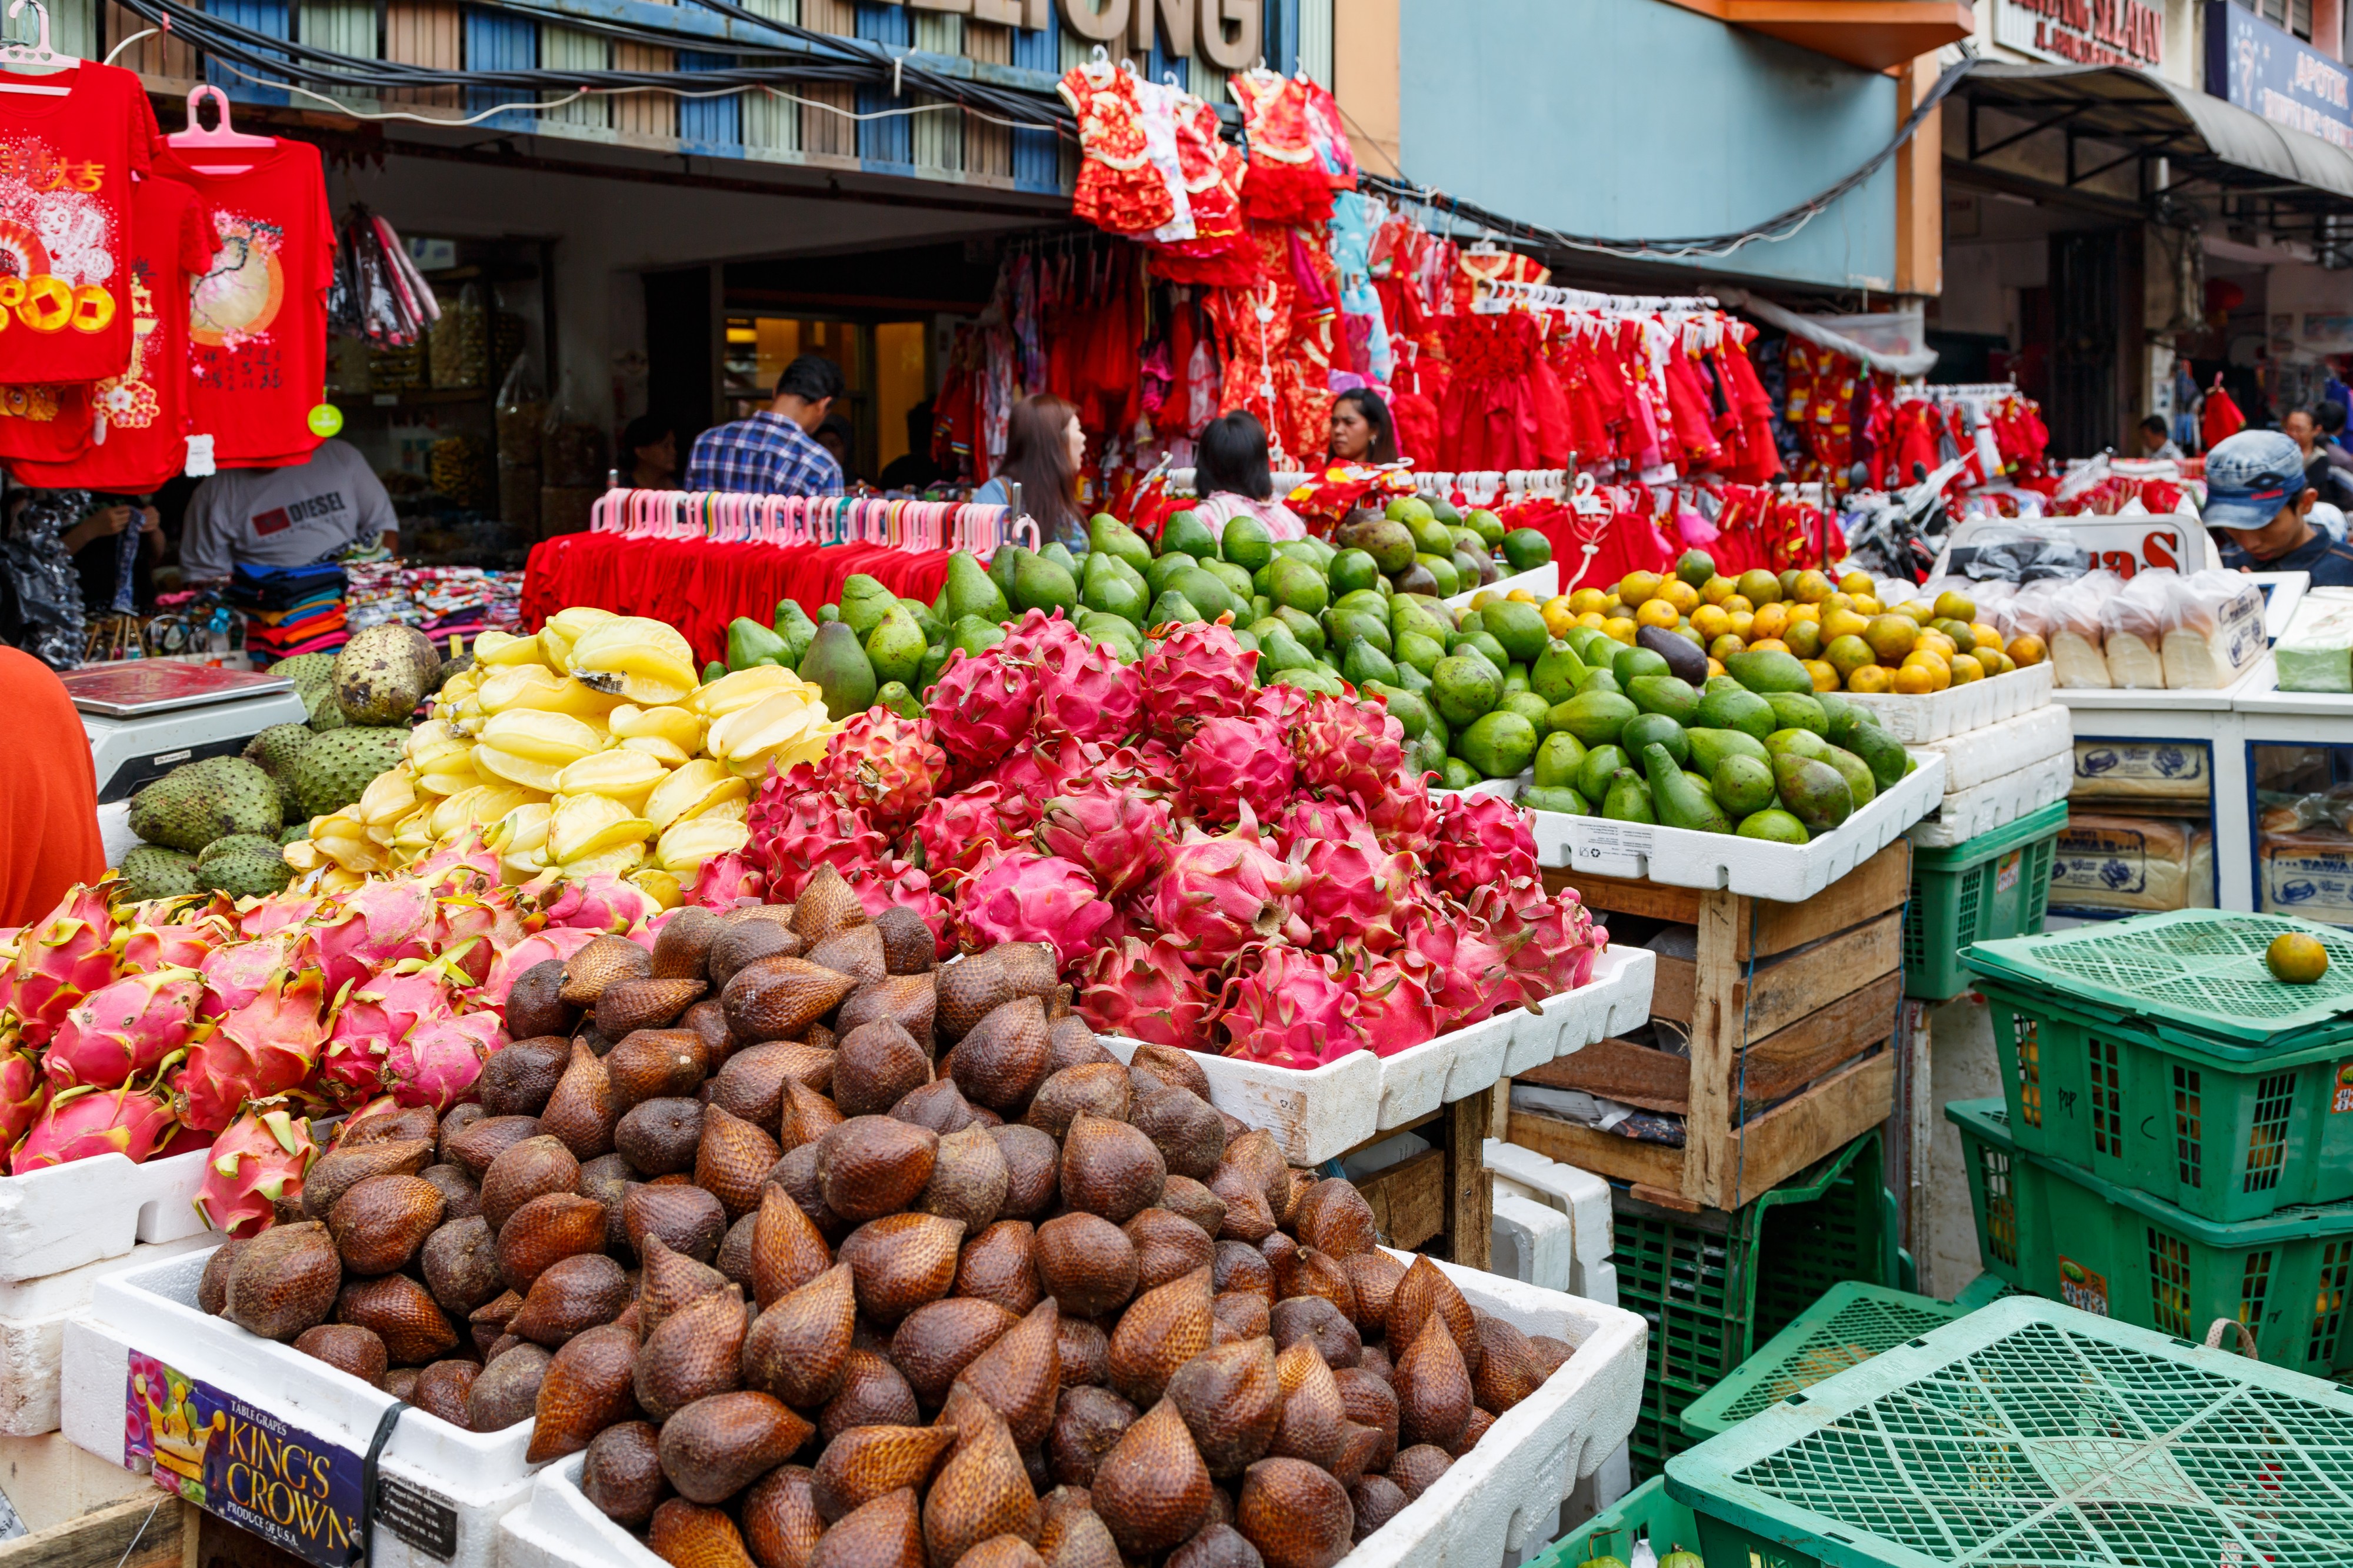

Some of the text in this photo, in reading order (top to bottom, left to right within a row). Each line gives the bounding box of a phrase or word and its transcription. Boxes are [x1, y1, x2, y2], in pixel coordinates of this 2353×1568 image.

[2294, 51, 2349, 111] APOTIK
[288, 491, 346, 522] DIESEL
[2299, 859, 2353, 874] TAWA
[231, 1400, 287, 1436] TABLE GRAPES
[228, 1415, 331, 1499] KING'S
[226, 1462, 354, 1550] CROWN
[227, 1500, 264, 1528] PRODUCE
